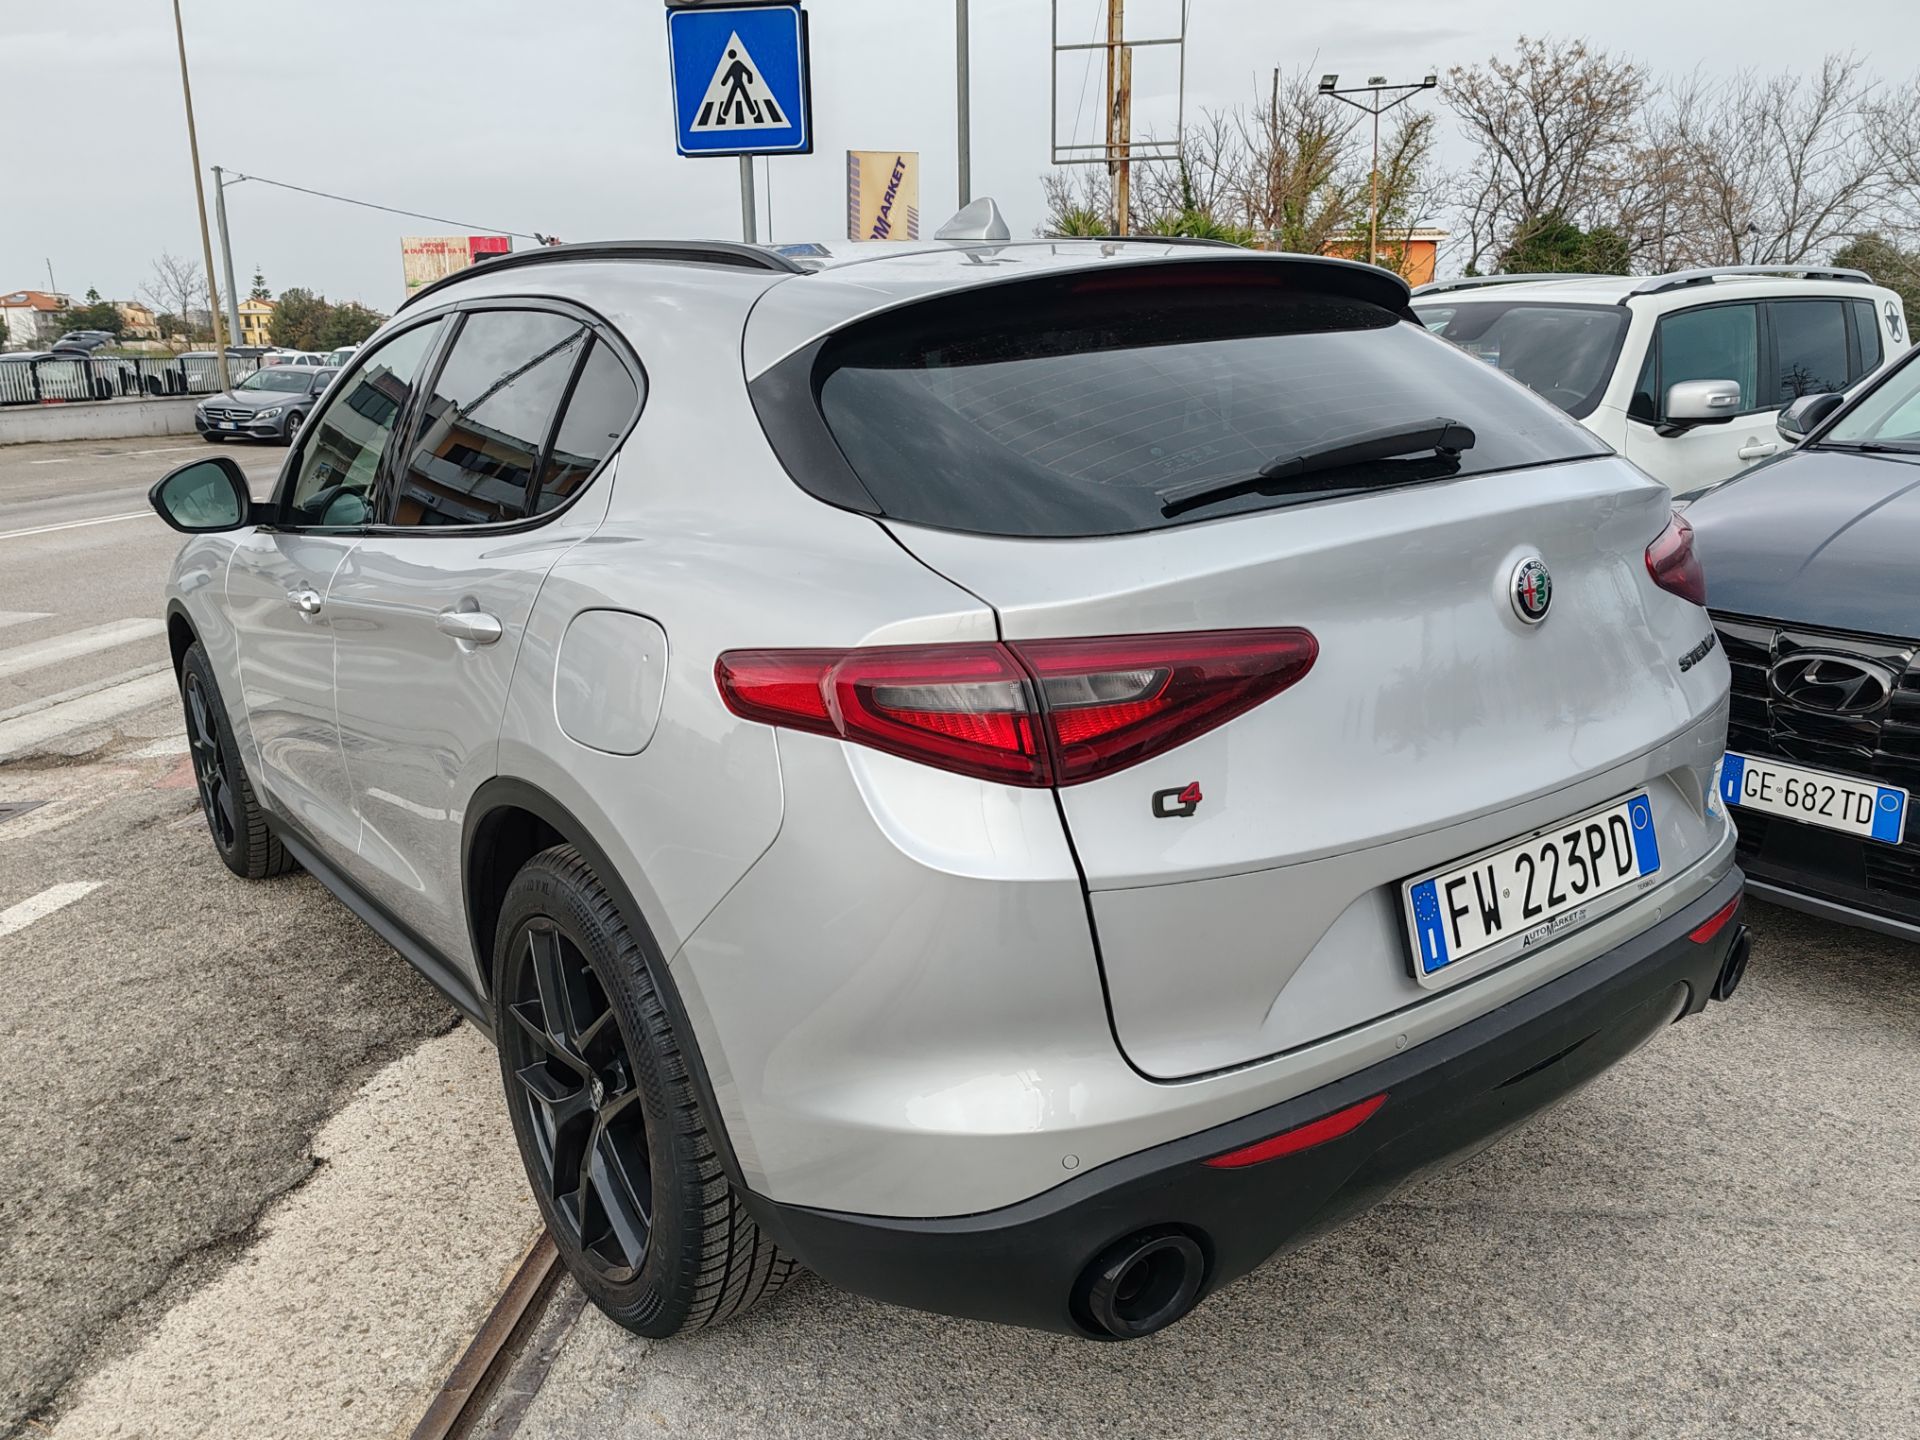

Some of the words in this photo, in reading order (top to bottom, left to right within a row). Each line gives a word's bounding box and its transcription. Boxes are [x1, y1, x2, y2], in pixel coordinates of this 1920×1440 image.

[1518, 567, 1530, 593] ALFA
[1151, 780, 1203, 818] Q4
[1743, 768, 1776, 803] GE
[1784, 777, 1874, 824] 682TD
[1445, 865, 1503, 949] FW
[1514, 813, 1634, 920] 223PD
